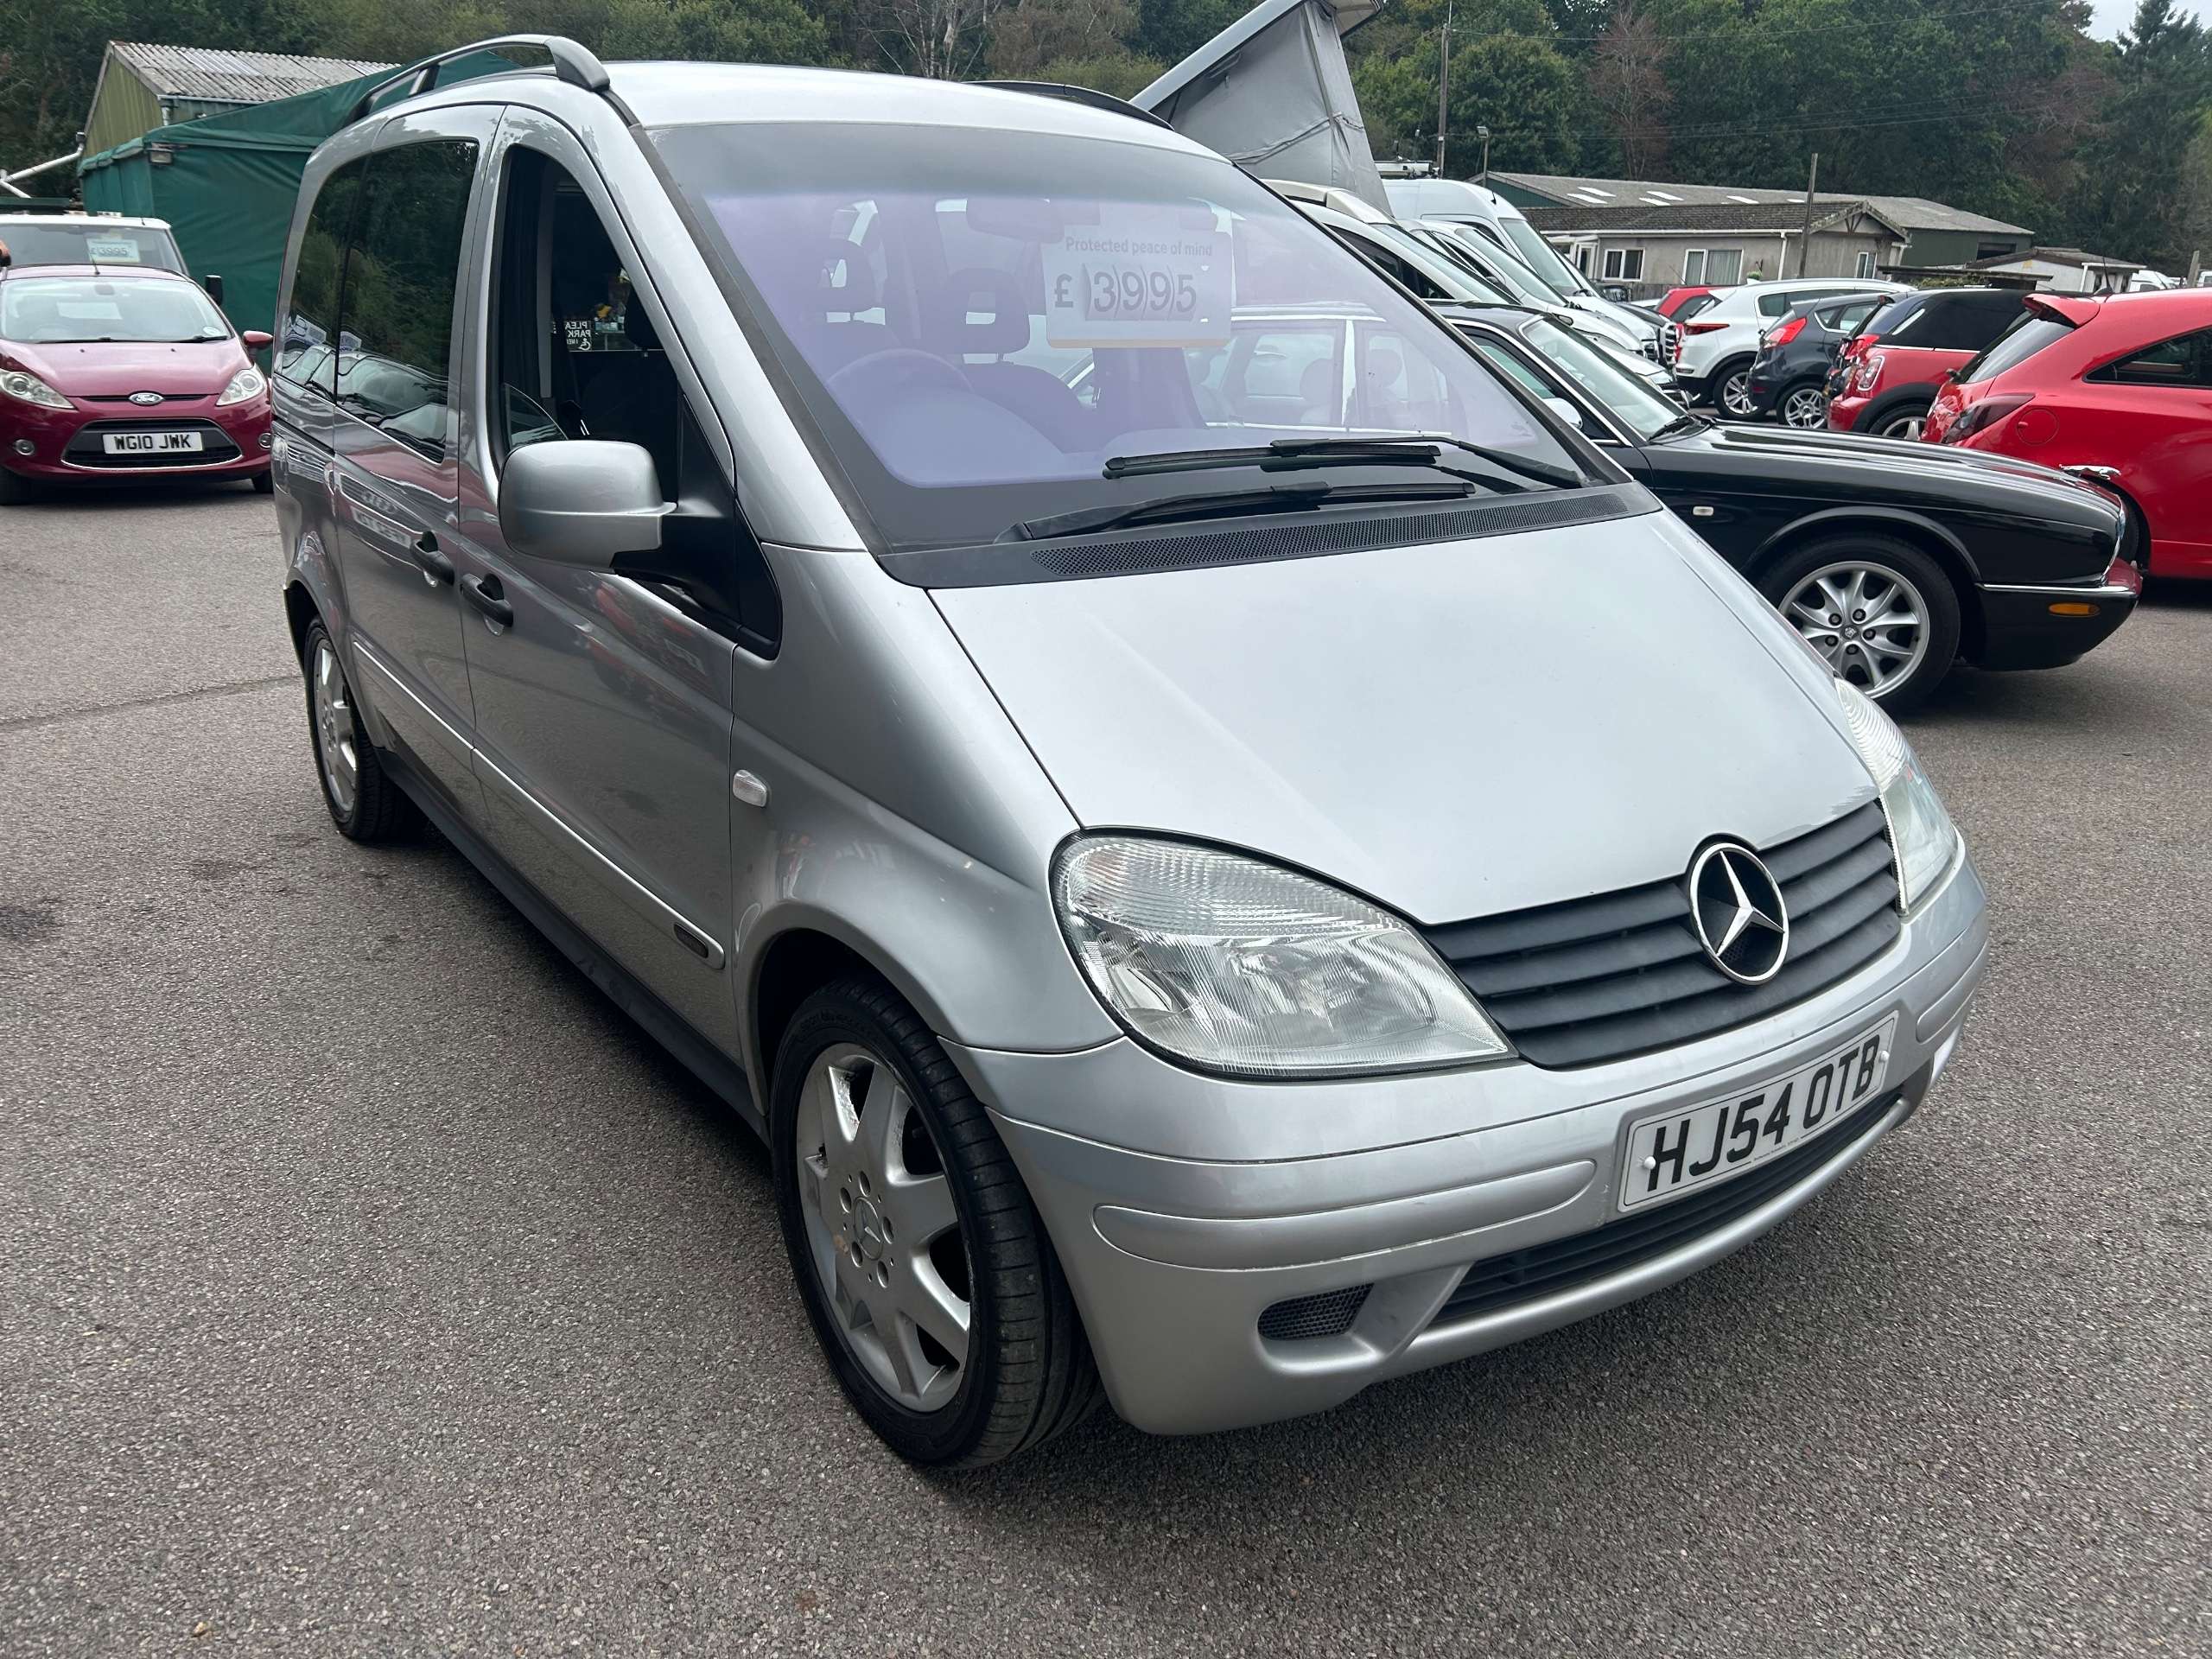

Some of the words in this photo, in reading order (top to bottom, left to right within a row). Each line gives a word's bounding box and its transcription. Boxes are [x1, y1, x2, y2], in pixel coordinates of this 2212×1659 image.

[1065, 236, 1128, 252] Protected
[1132, 241, 1166, 256] peace
[1170, 241, 1182, 256] of
[1185, 243, 1212, 257] mind
[1093, 270, 1197, 313] 3995
[114, 435, 154, 451] WG10
[158, 434, 193, 449] JWK
[1647, 1082, 1794, 1192] HJ54
[1802, 1034, 1880, 1129] OTB
